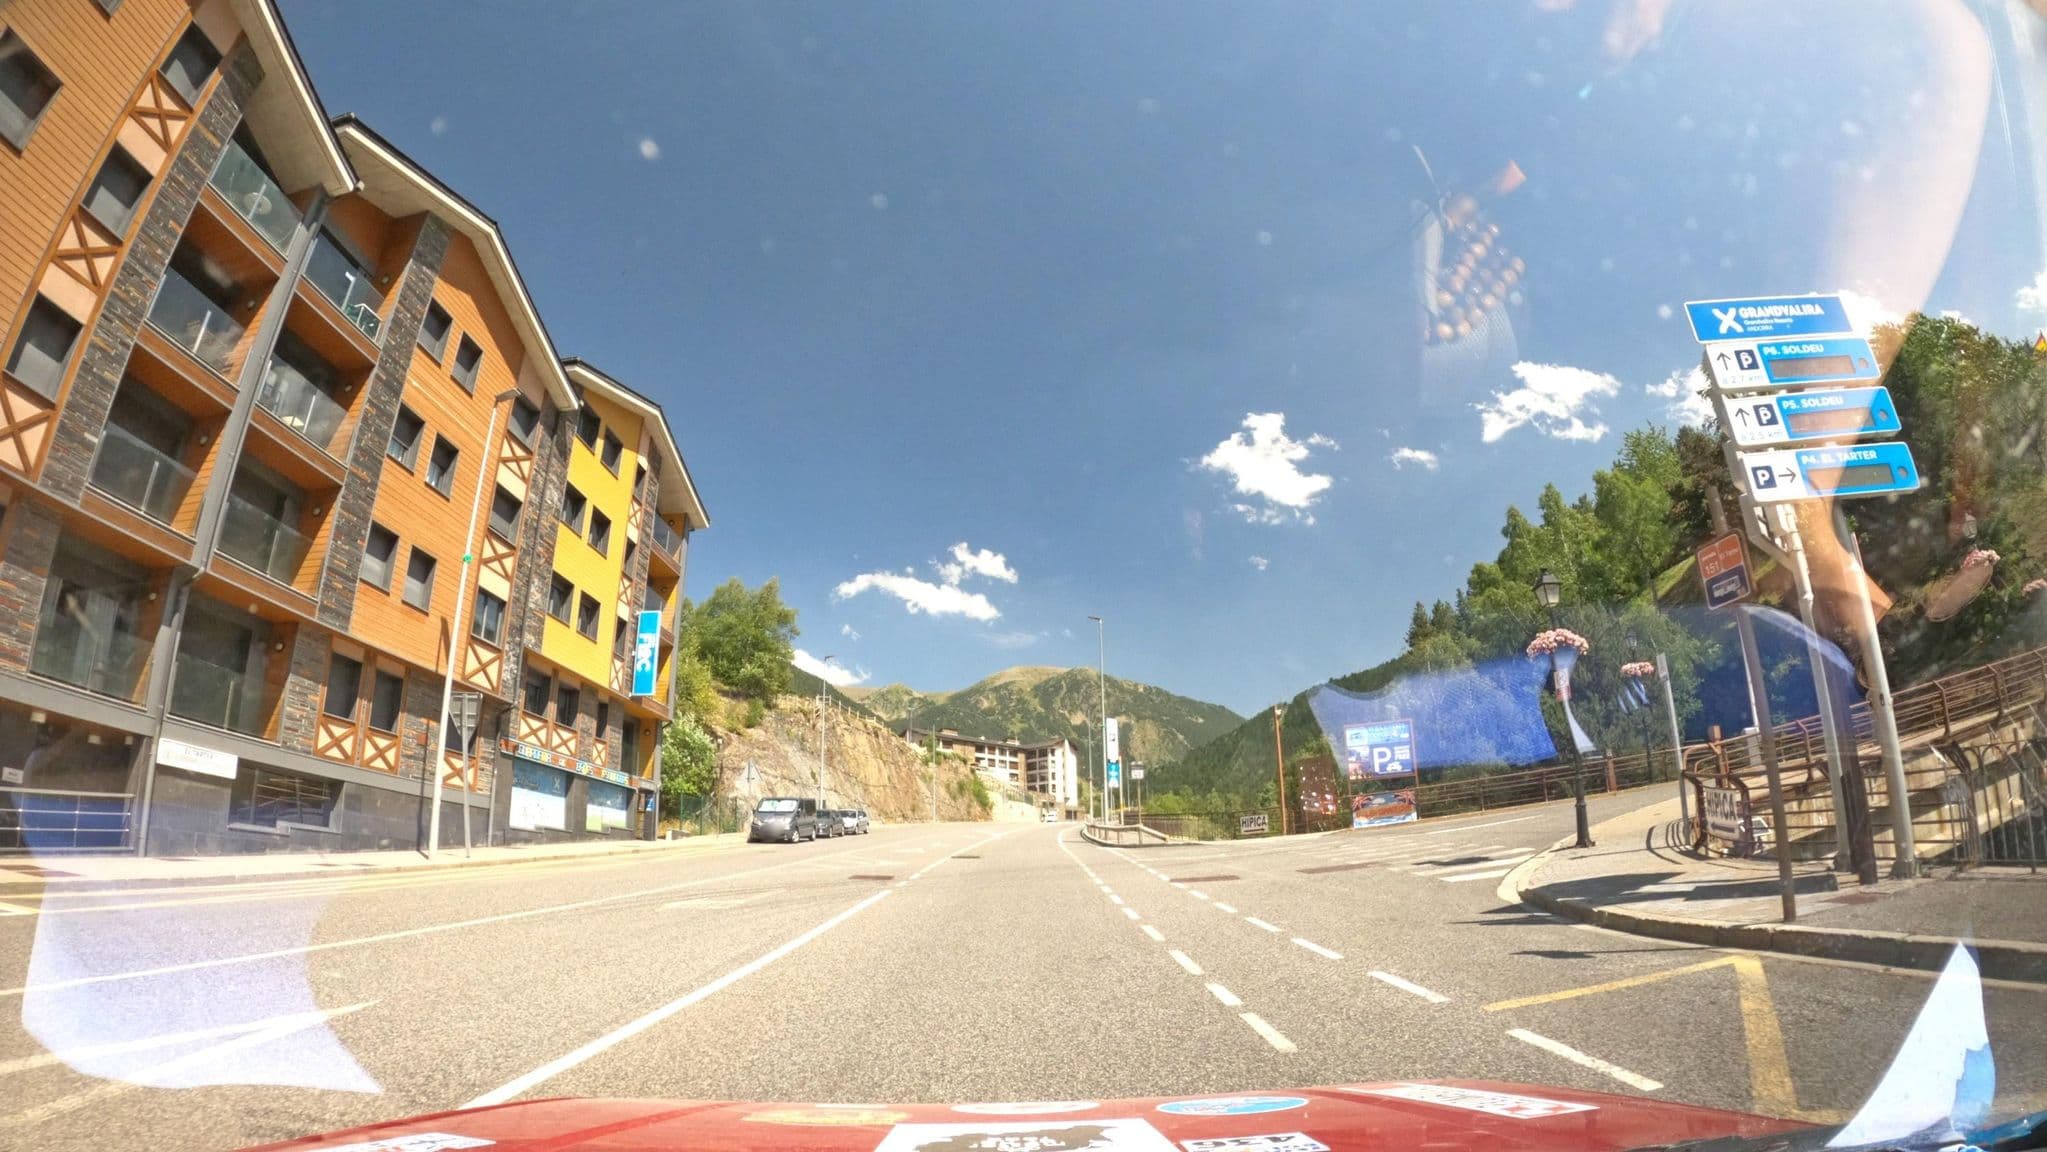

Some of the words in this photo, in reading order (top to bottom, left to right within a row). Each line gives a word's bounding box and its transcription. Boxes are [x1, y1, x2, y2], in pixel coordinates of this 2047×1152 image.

[1739, 304, 1824, 318] GRANDVALIRA
[1781, 344, 1824, 355] SOLDEU
[1801, 396, 1844, 408] SOLDEU
[1822, 453, 1836, 463] EL
[1837, 450, 1878, 463] TARTER
[1706, 792, 1736, 821] HIPICA
[1241, 815, 1267, 828] HIPICA
